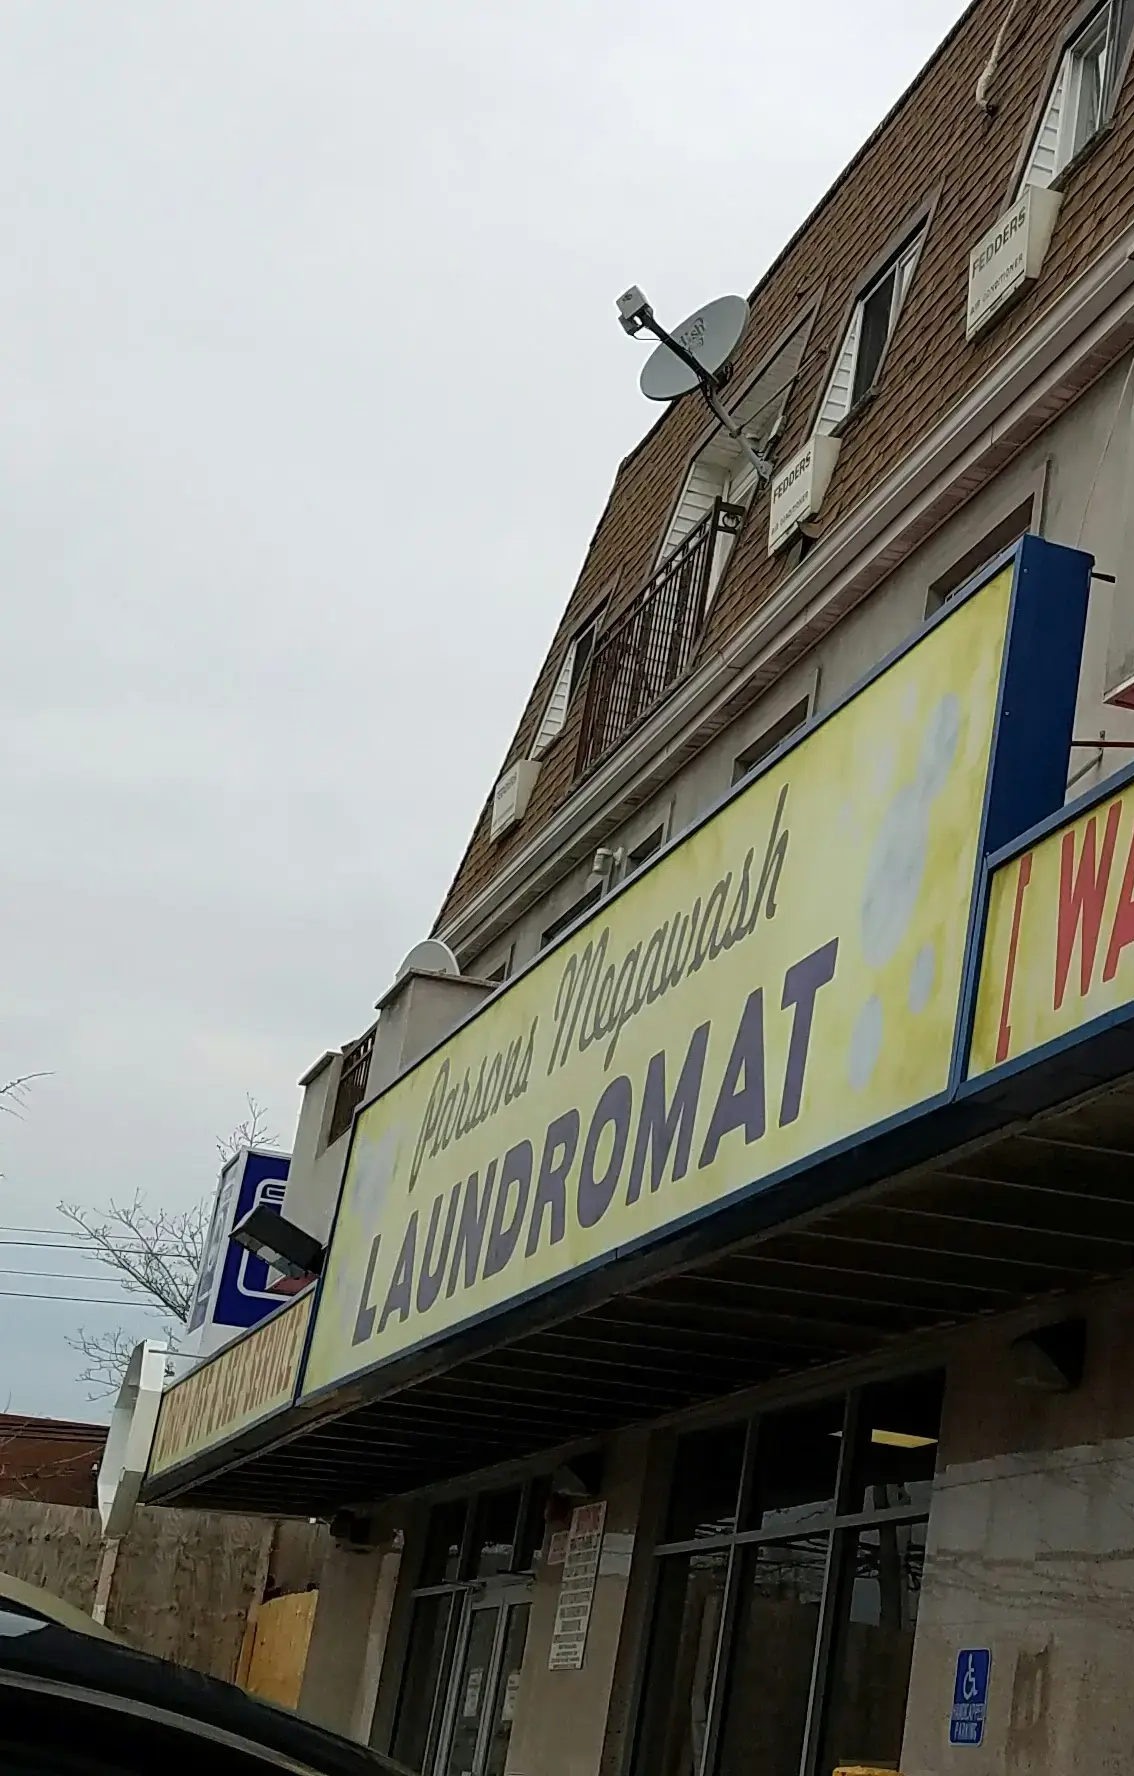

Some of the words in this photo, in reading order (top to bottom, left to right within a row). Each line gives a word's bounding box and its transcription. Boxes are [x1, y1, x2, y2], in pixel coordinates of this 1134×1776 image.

[971, 206, 1027, 280] FEDDERS
[981, 252, 1024, 304] CONDITIONER
[772, 450, 812, 505] FEDDERS
[407, 1013, 539, 1195] Parsons
[546, 782, 791, 1078] Megawash
[350, 935, 841, 1348] LAUNDROMAT
[241, 1300, 304, 1413] SERVICE
